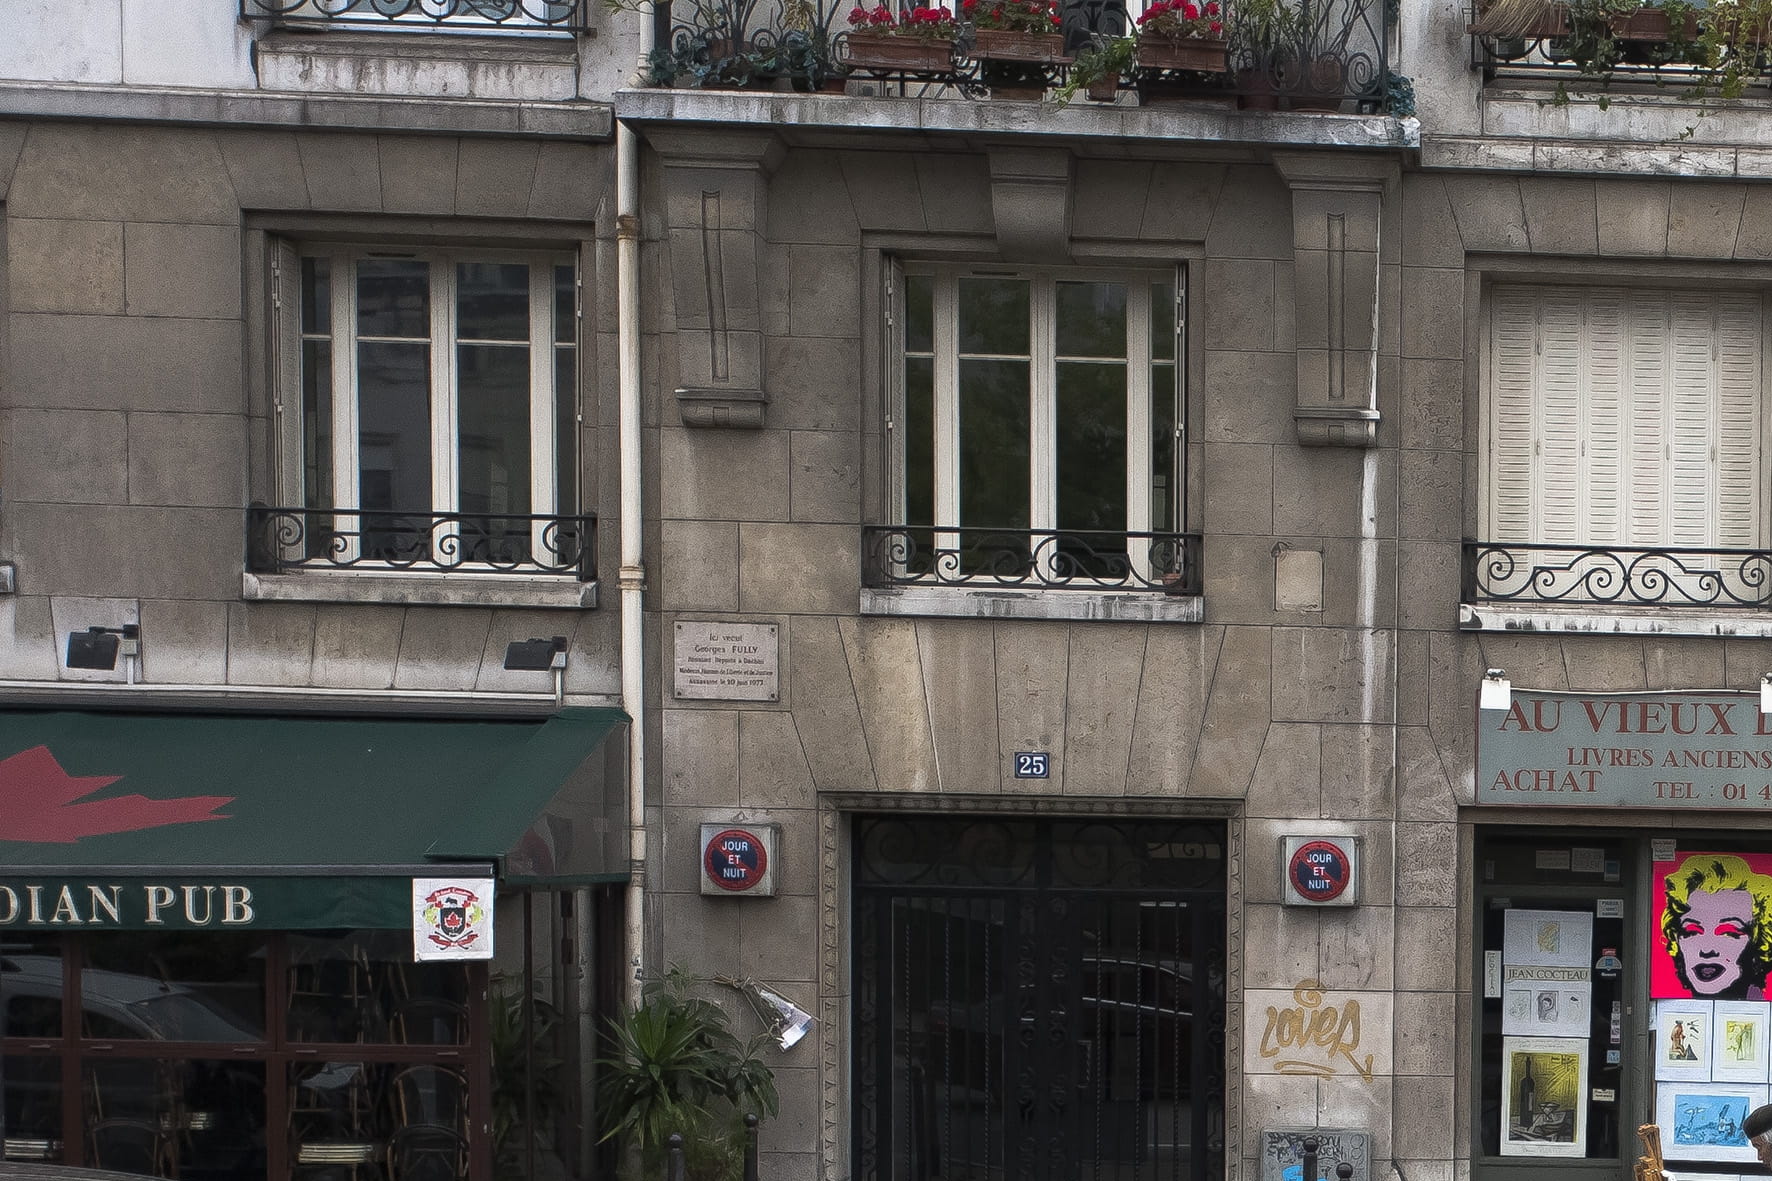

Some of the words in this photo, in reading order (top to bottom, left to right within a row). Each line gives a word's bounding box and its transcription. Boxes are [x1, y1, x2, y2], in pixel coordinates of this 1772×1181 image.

[732, 645, 758, 654] FULLY
[1497, 699, 1563, 733] AU
[1580, 700, 1738, 737] VIEUX
[1566, 747, 1654, 767] LIVRES
[1662, 749, 1772, 770] ANCIENS
[1019, 755, 1045, 775] 25
[1490, 768, 1604, 793] ACHAT
[1652, 780, 1700, 800] TEL
[1722, 782, 1748, 801] 01
[721, 840, 749, 852] JOUR
[728, 854, 741, 865] ET
[1306, 853, 1332, 863] JOUR
[723, 867, 747, 878] NUIT
[1313, 866, 1325, 876] ET
[1308, 879, 1331, 889] NUIT
[143, 884, 256, 926] PUB
[1506, 968, 1534, 979] JEAN
[1536, 969, 1589, 981] COCTEAU
